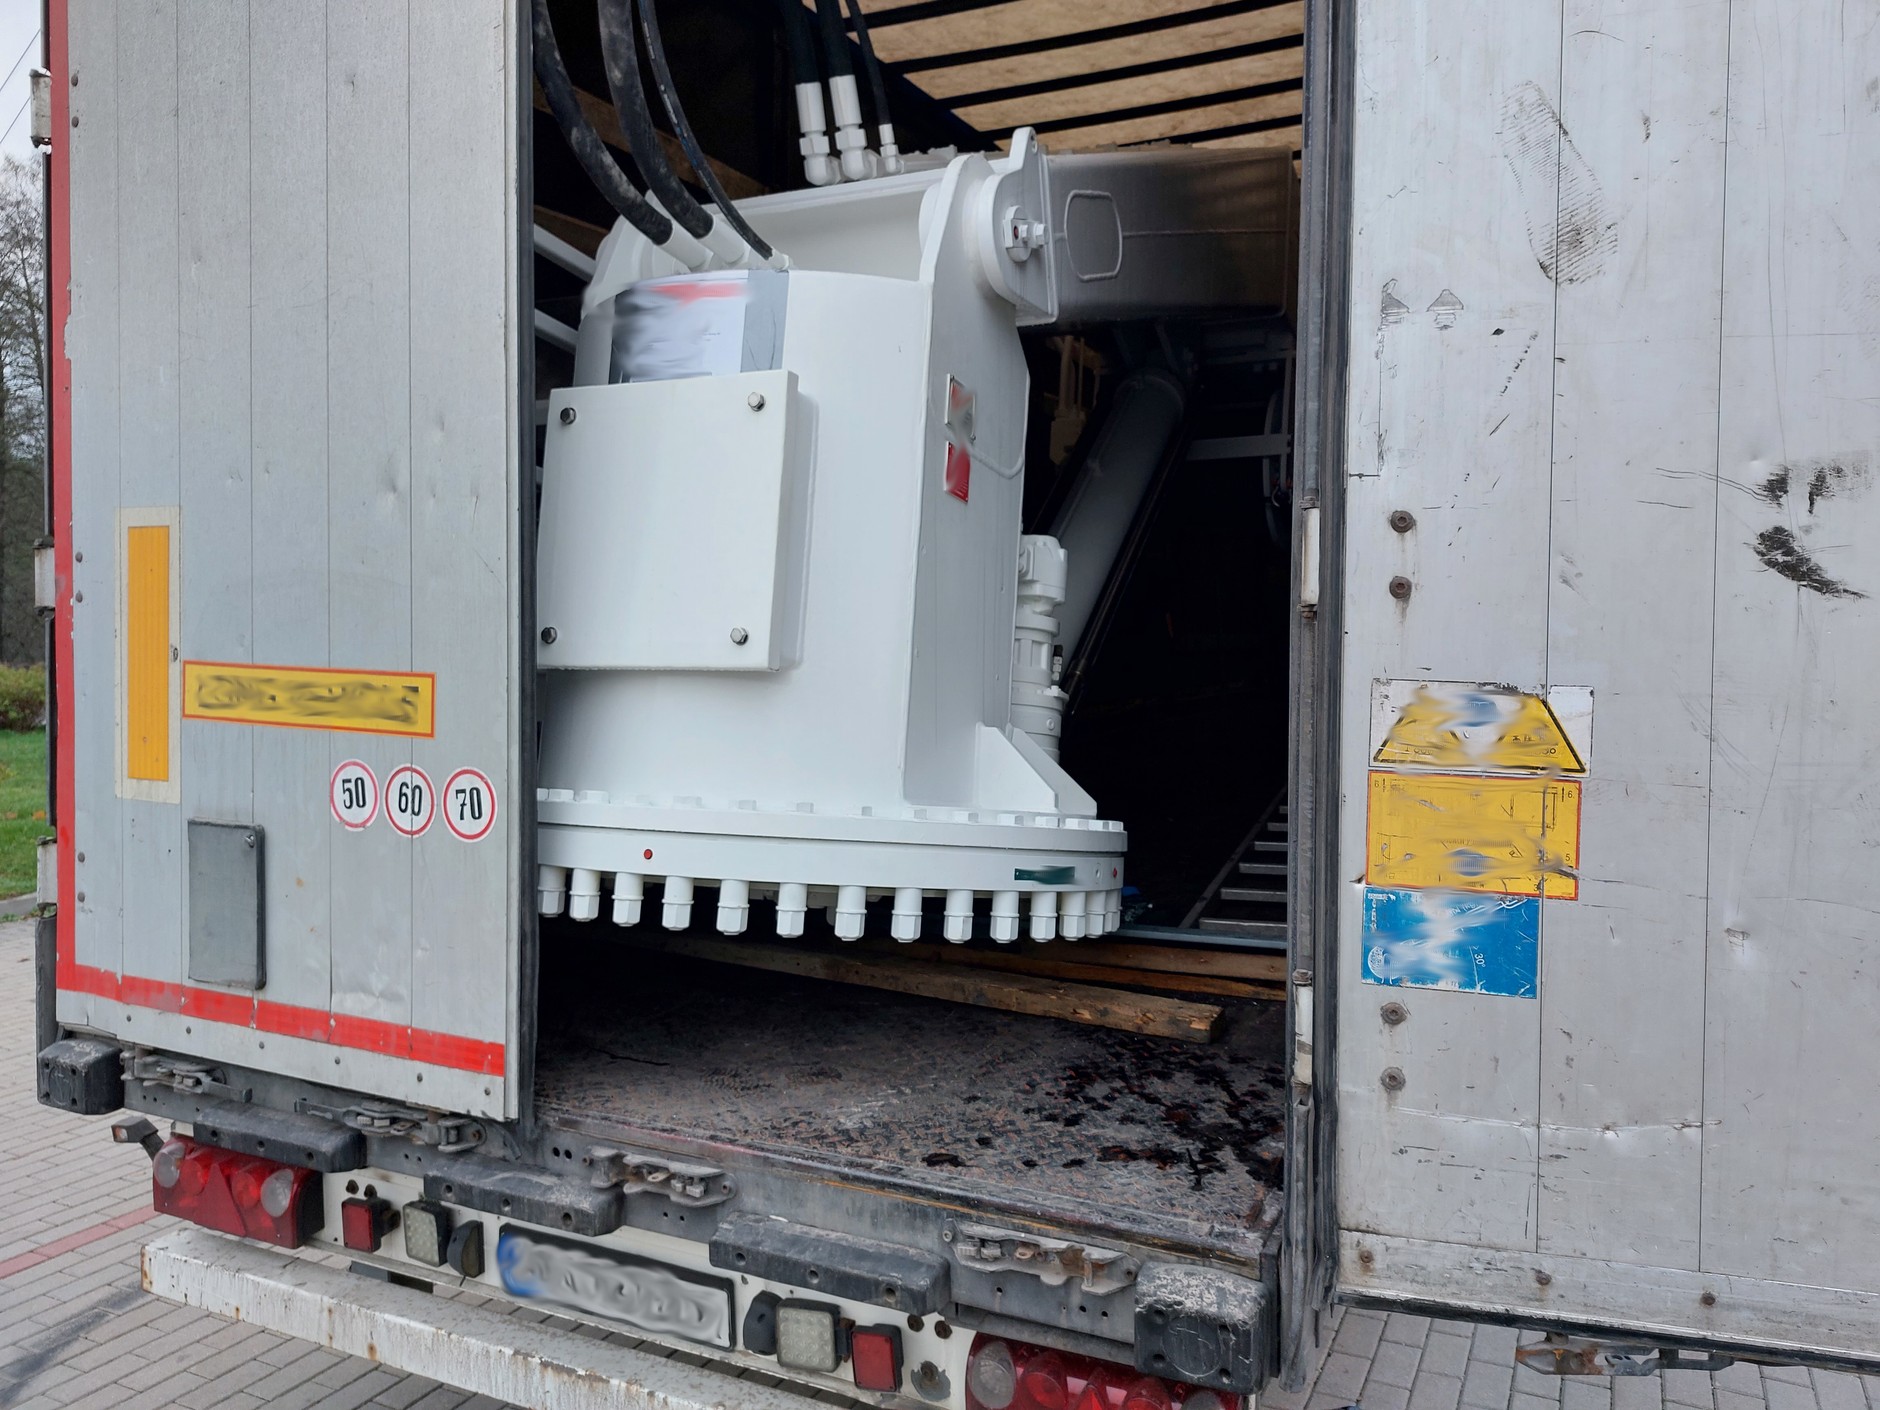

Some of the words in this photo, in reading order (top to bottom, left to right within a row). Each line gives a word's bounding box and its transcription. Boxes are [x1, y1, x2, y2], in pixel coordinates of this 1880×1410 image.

[341, 777, 367, 809] 50
[398, 781, 423, 816] 60
[455, 787, 483, 820] 70
